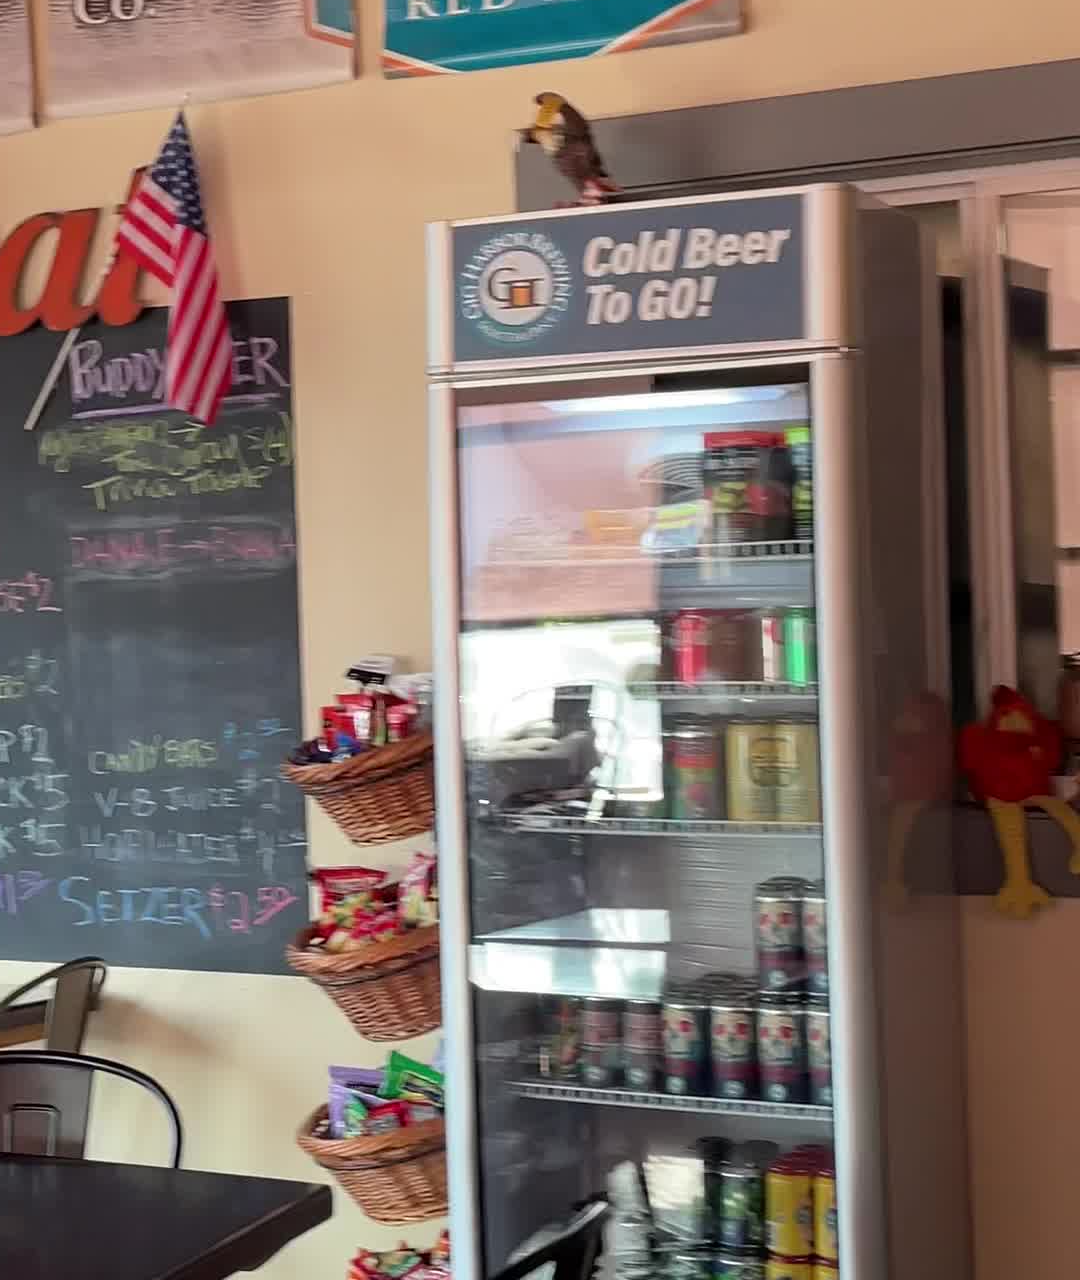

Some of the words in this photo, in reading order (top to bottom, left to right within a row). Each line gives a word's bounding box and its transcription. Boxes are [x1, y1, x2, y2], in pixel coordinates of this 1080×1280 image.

[583, 227, 682, 279] Cold
[683, 226, 793, 271] Beer
[587, 283, 632, 326] To
